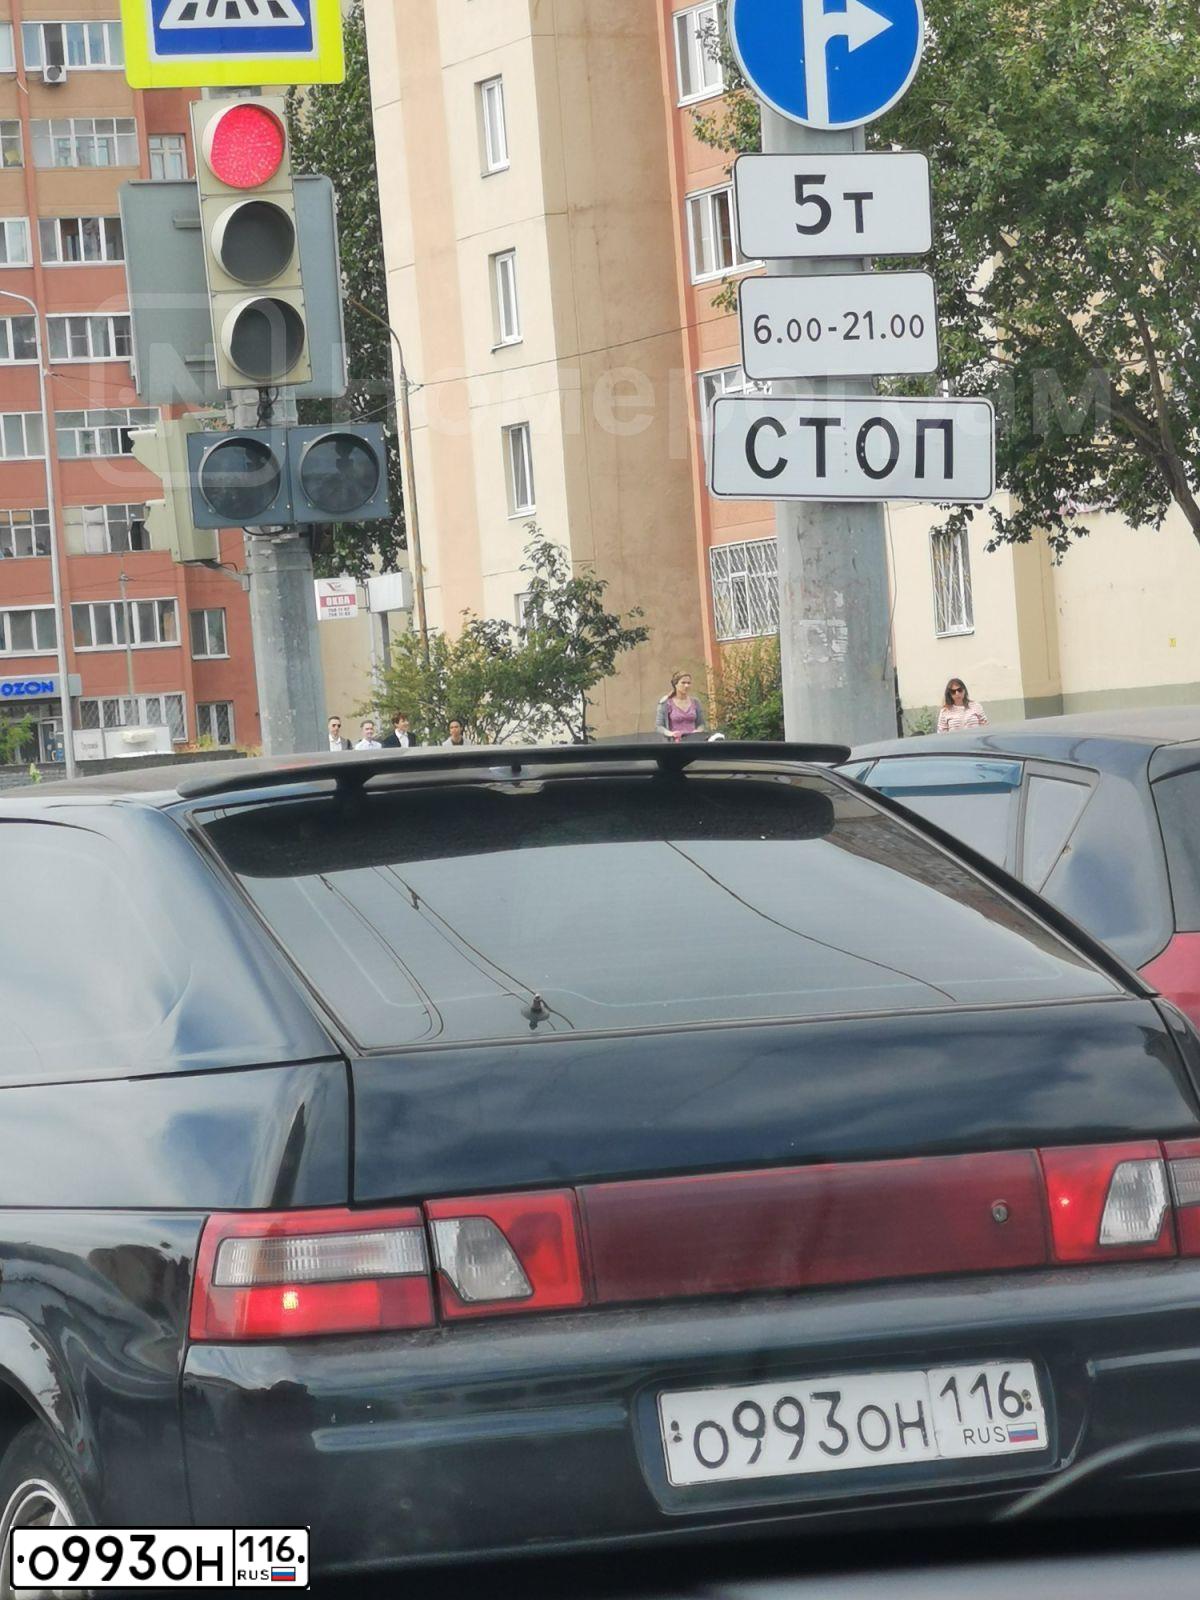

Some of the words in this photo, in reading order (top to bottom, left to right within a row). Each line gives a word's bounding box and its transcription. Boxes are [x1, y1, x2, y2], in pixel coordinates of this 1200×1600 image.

[753, 311, 925, 345] 6.00-21.00
[745, 416, 954, 480] СТОП
[1, 681, 55, 696] OZON
[938, 1371, 1025, 1424] 116
[962, 1425, 1006, 1445] RUS
